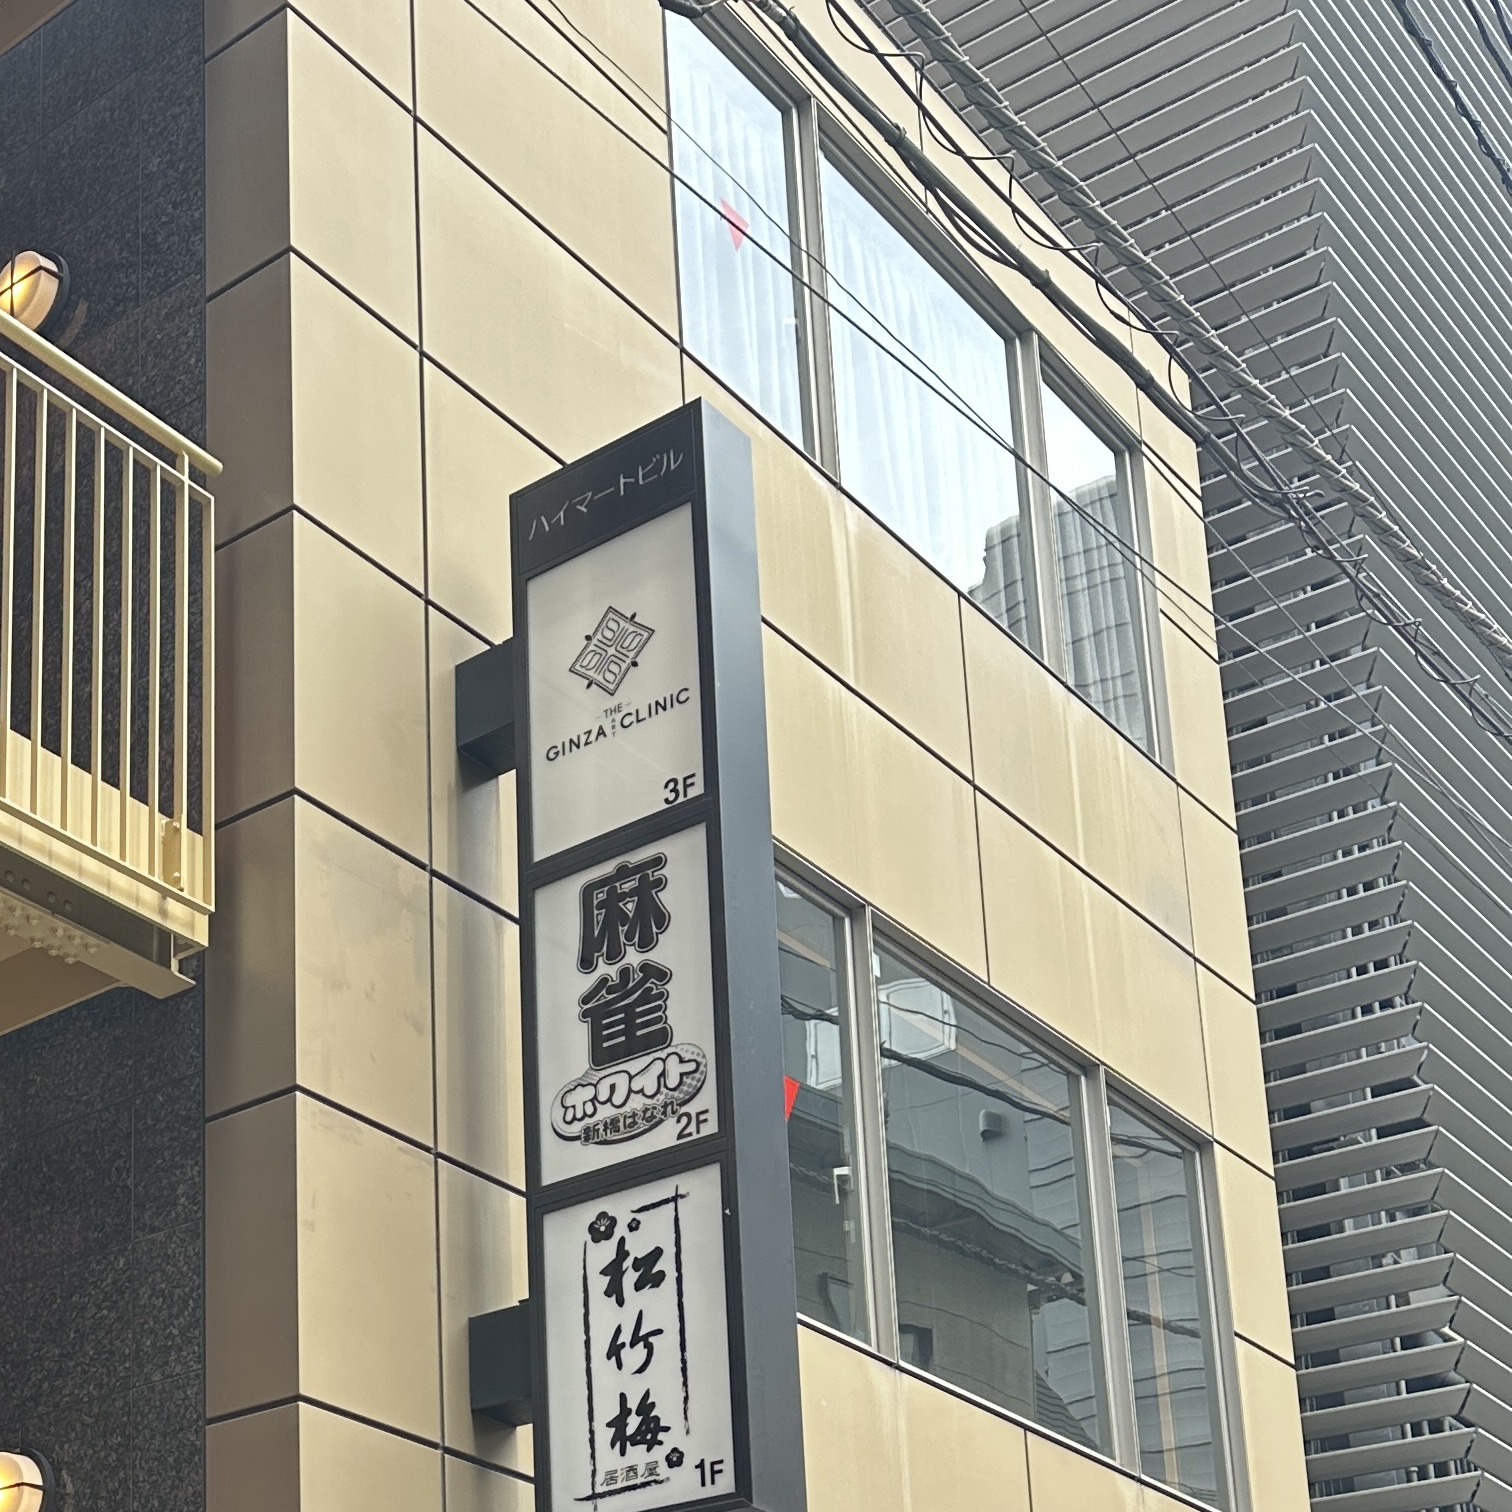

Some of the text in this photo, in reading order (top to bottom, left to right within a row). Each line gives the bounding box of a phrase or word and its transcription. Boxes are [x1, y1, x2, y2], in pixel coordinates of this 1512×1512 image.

[529, 449, 683, 541] ハイマートビル
[545, 724, 607, 762] GINZA
[619, 687, 691, 729] CLINIC
[603, 702, 623, 719] THE
[663, 772, 696, 805] 3F
[577, 852, 673, 1071] 麻雀
[561, 1052, 701, 1125] ホワイト
[582, 1099, 679, 1145] 新橋はなれ
[676, 1108, 709, 1141] 2F
[599, 1235, 672, 1457] 松竹梅
[600, 1460, 660, 1487] 居酒屋
[694, 1458, 725, 1488] 1F
